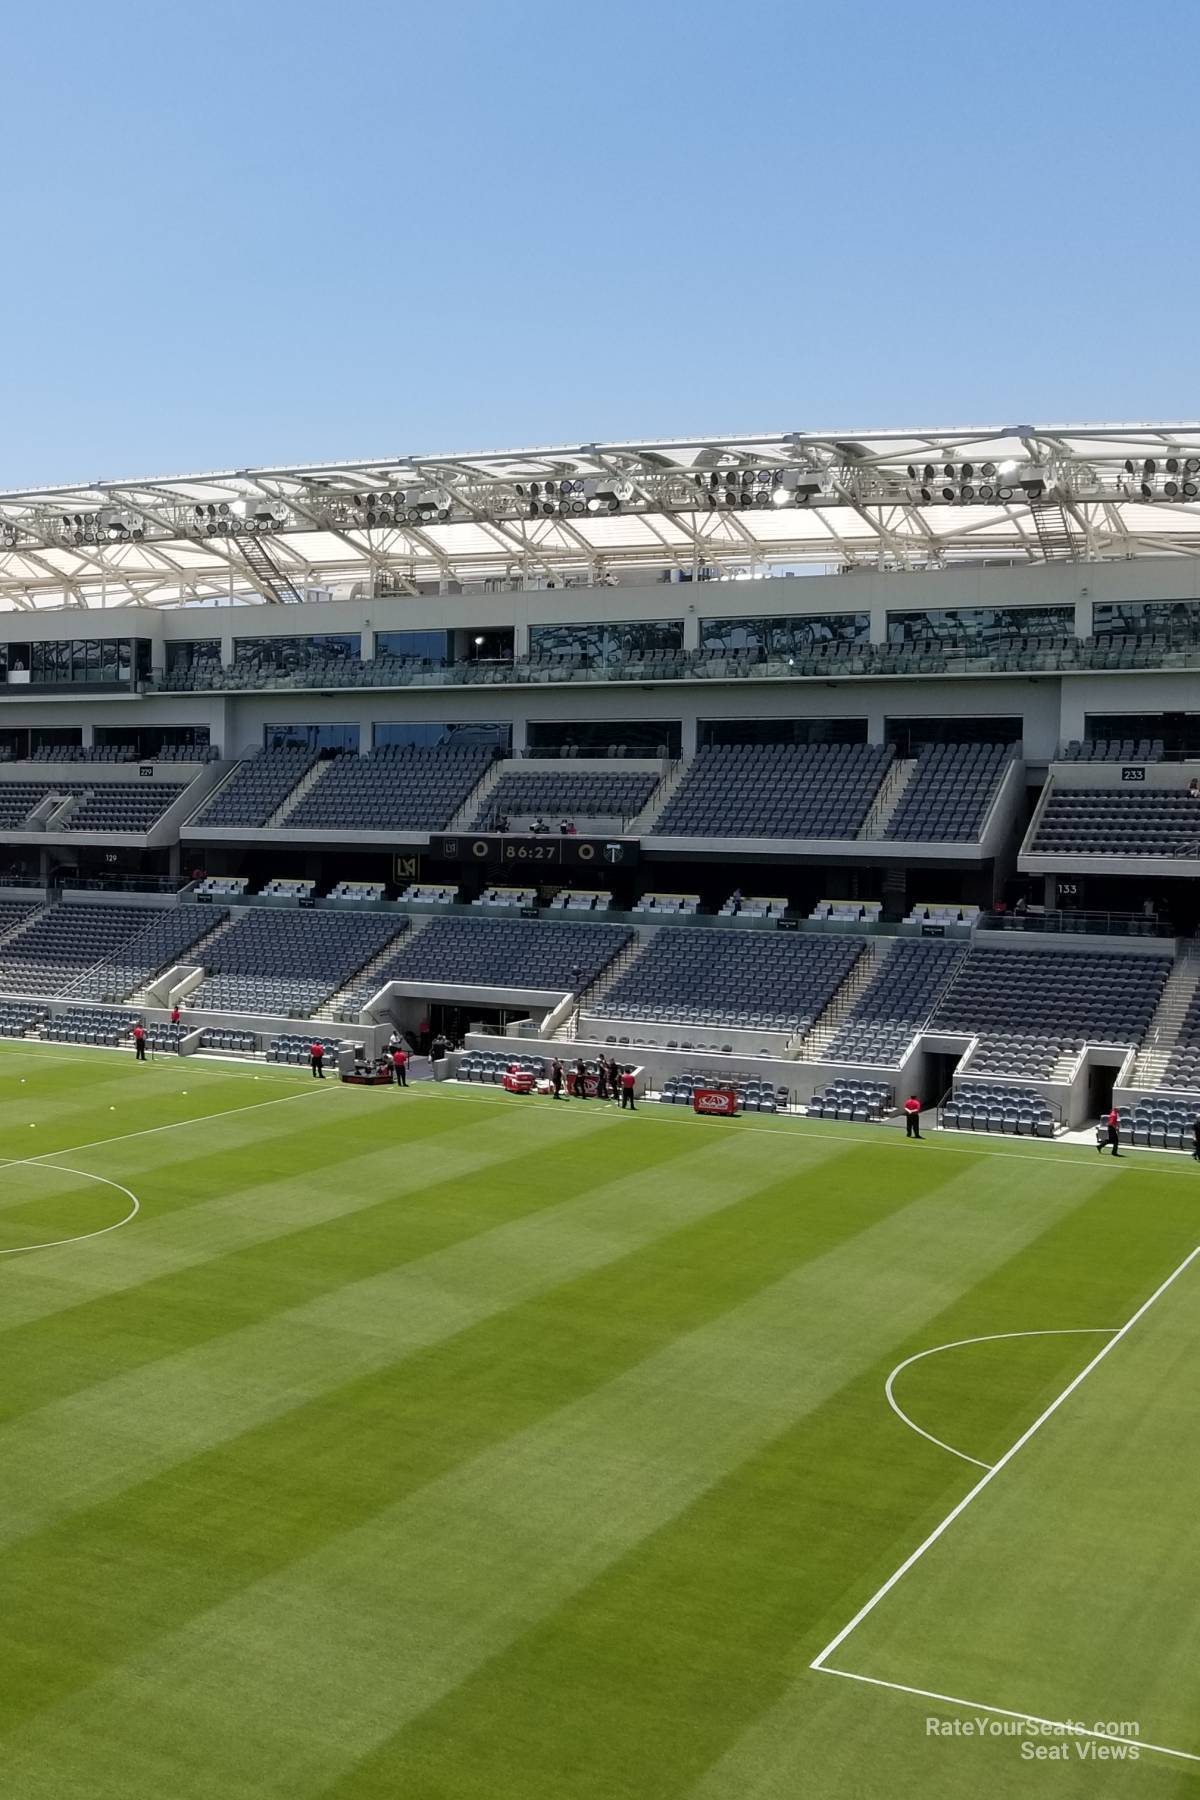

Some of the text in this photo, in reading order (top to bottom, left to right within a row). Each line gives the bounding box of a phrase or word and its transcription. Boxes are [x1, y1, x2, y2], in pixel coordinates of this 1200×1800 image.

[140, 767, 152, 775] 229
[1124, 771, 1144, 780] 233
[506, 846, 555, 859] 86:27
[106, 854, 118, 862] 129
[1058, 884, 1077, 894] 133
